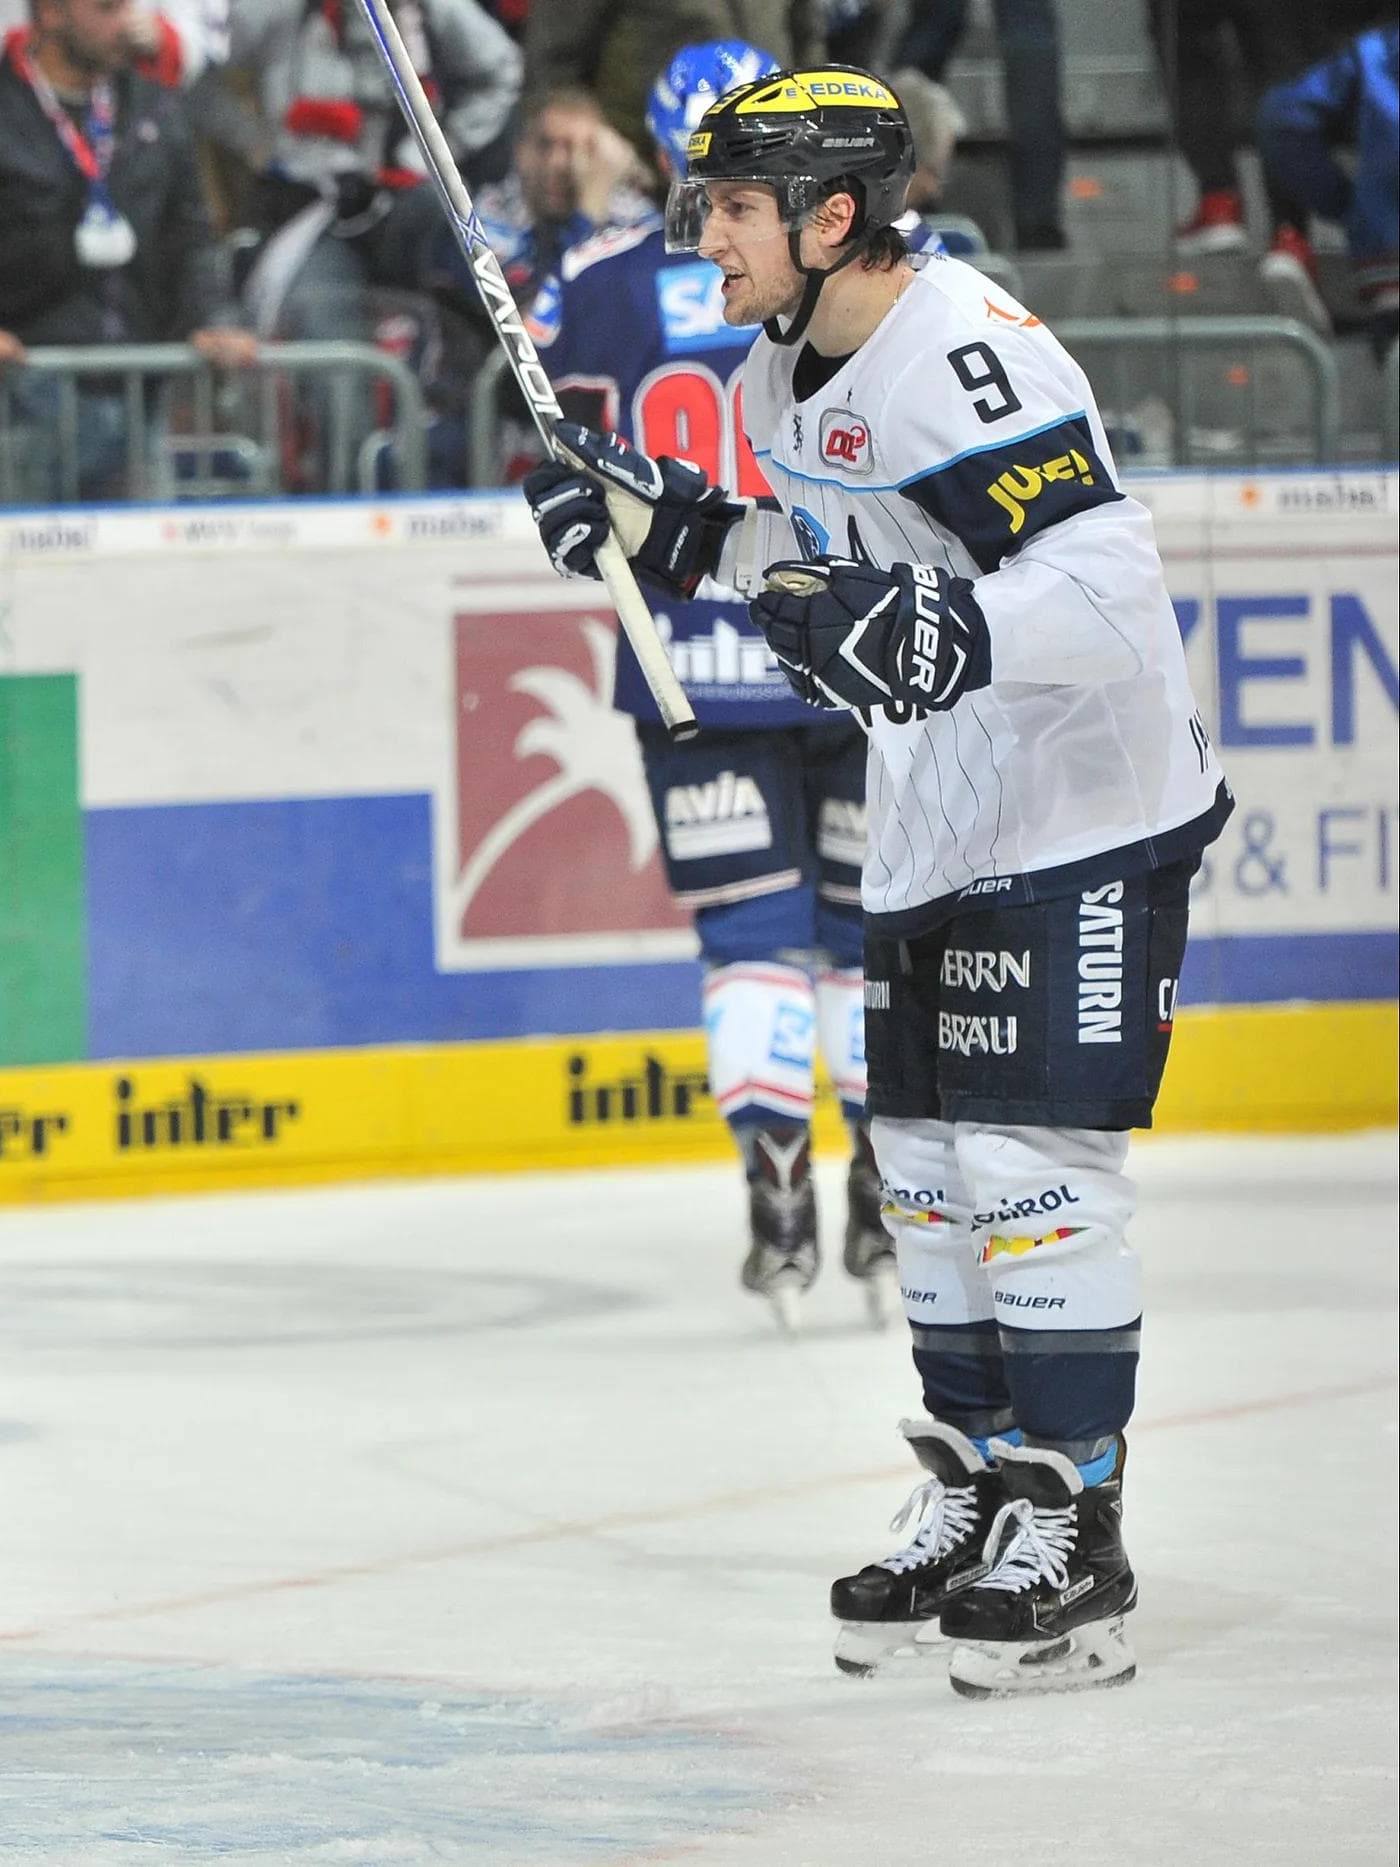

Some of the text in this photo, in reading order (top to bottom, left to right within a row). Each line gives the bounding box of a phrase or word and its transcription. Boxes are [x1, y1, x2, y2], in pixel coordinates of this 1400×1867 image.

[810, 82, 888, 101] EDEKA
[822, 137, 876, 149] BAUER
[946, 341, 1023, 424] 9
[908, 562, 943, 694] AUER
[1232, 808, 1290, 898] &
[1077, 879, 1125, 1044] SATURN
[938, 1010, 1018, 1057] BRÄU
[112, 1074, 300, 1150] inter
[994, 1290, 1068, 1310] BAUER
